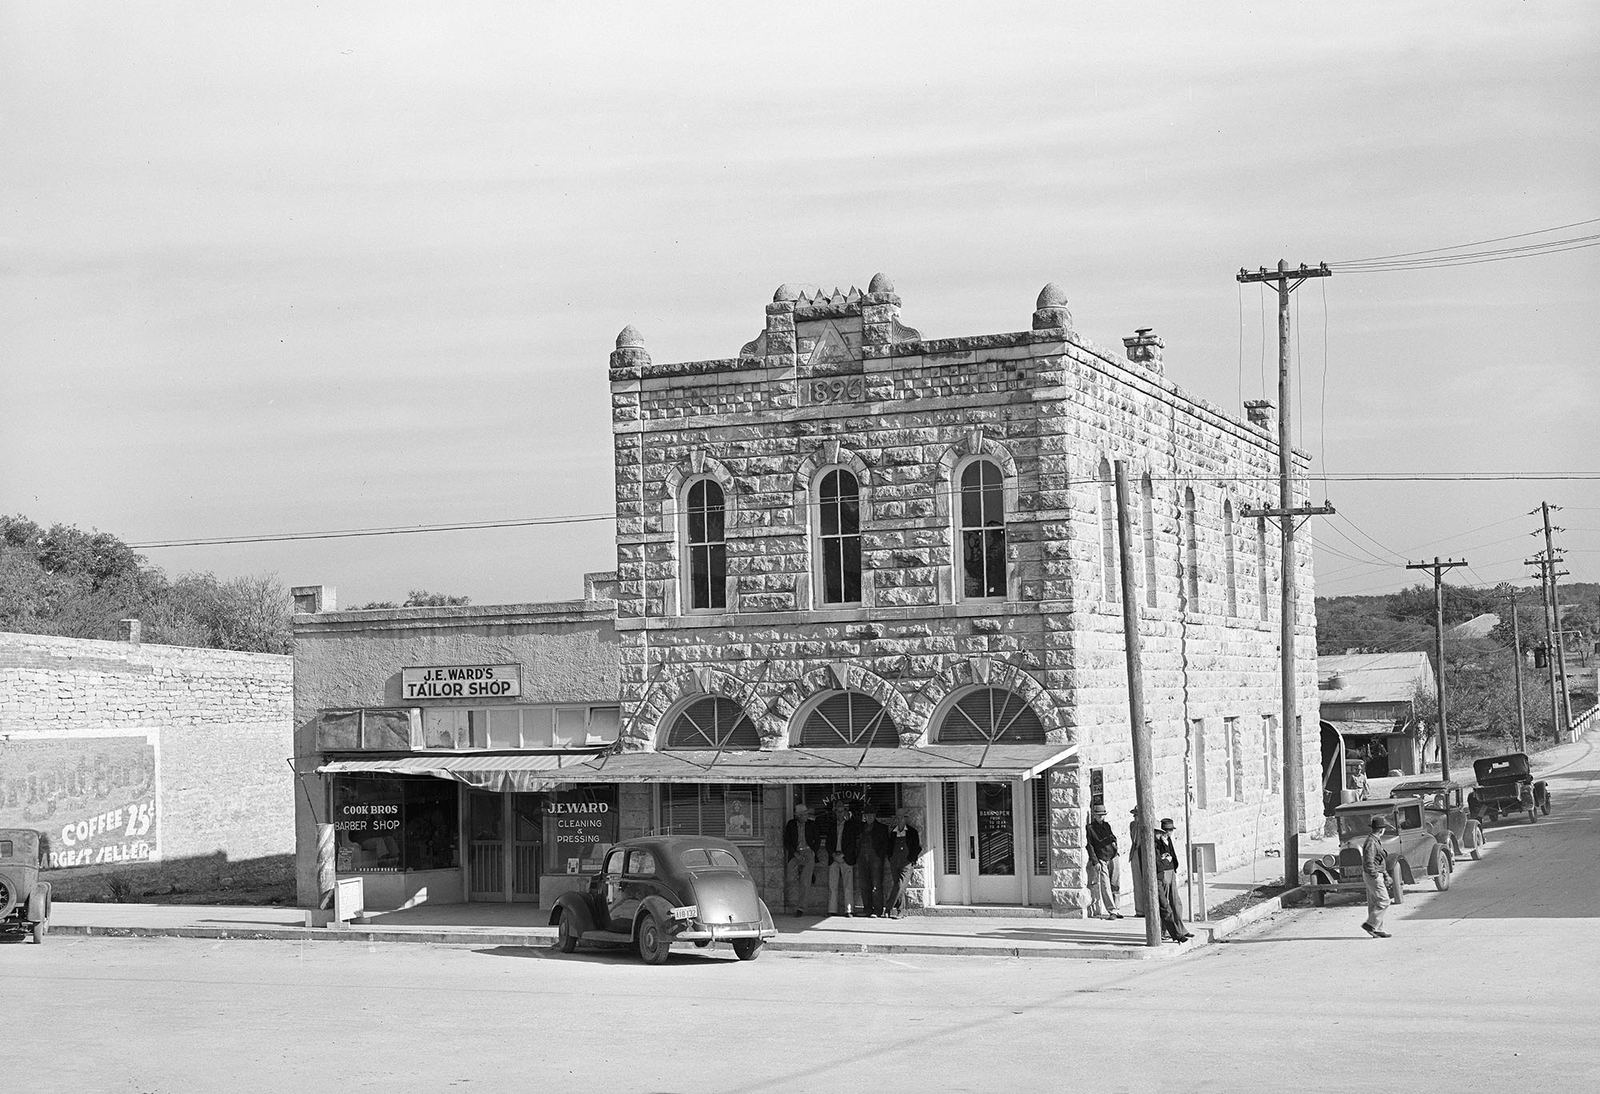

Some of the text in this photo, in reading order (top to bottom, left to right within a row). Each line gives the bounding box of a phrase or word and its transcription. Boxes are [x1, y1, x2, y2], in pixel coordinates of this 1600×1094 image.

[808, 379, 861, 402] 1896
[408, 681, 511, 696] TAILOR SHOP
[822, 790, 872, 806] NATIONAL
[343, 805, 398, 815] COOK BROS
[62, 809, 122, 846] COFFEE
[334, 820, 400, 831] BARBER SHOP
[558, 819, 602, 828] CLEANING
[557, 835, 600, 843] PRESSING
[96, 843, 149, 863] SELLER
